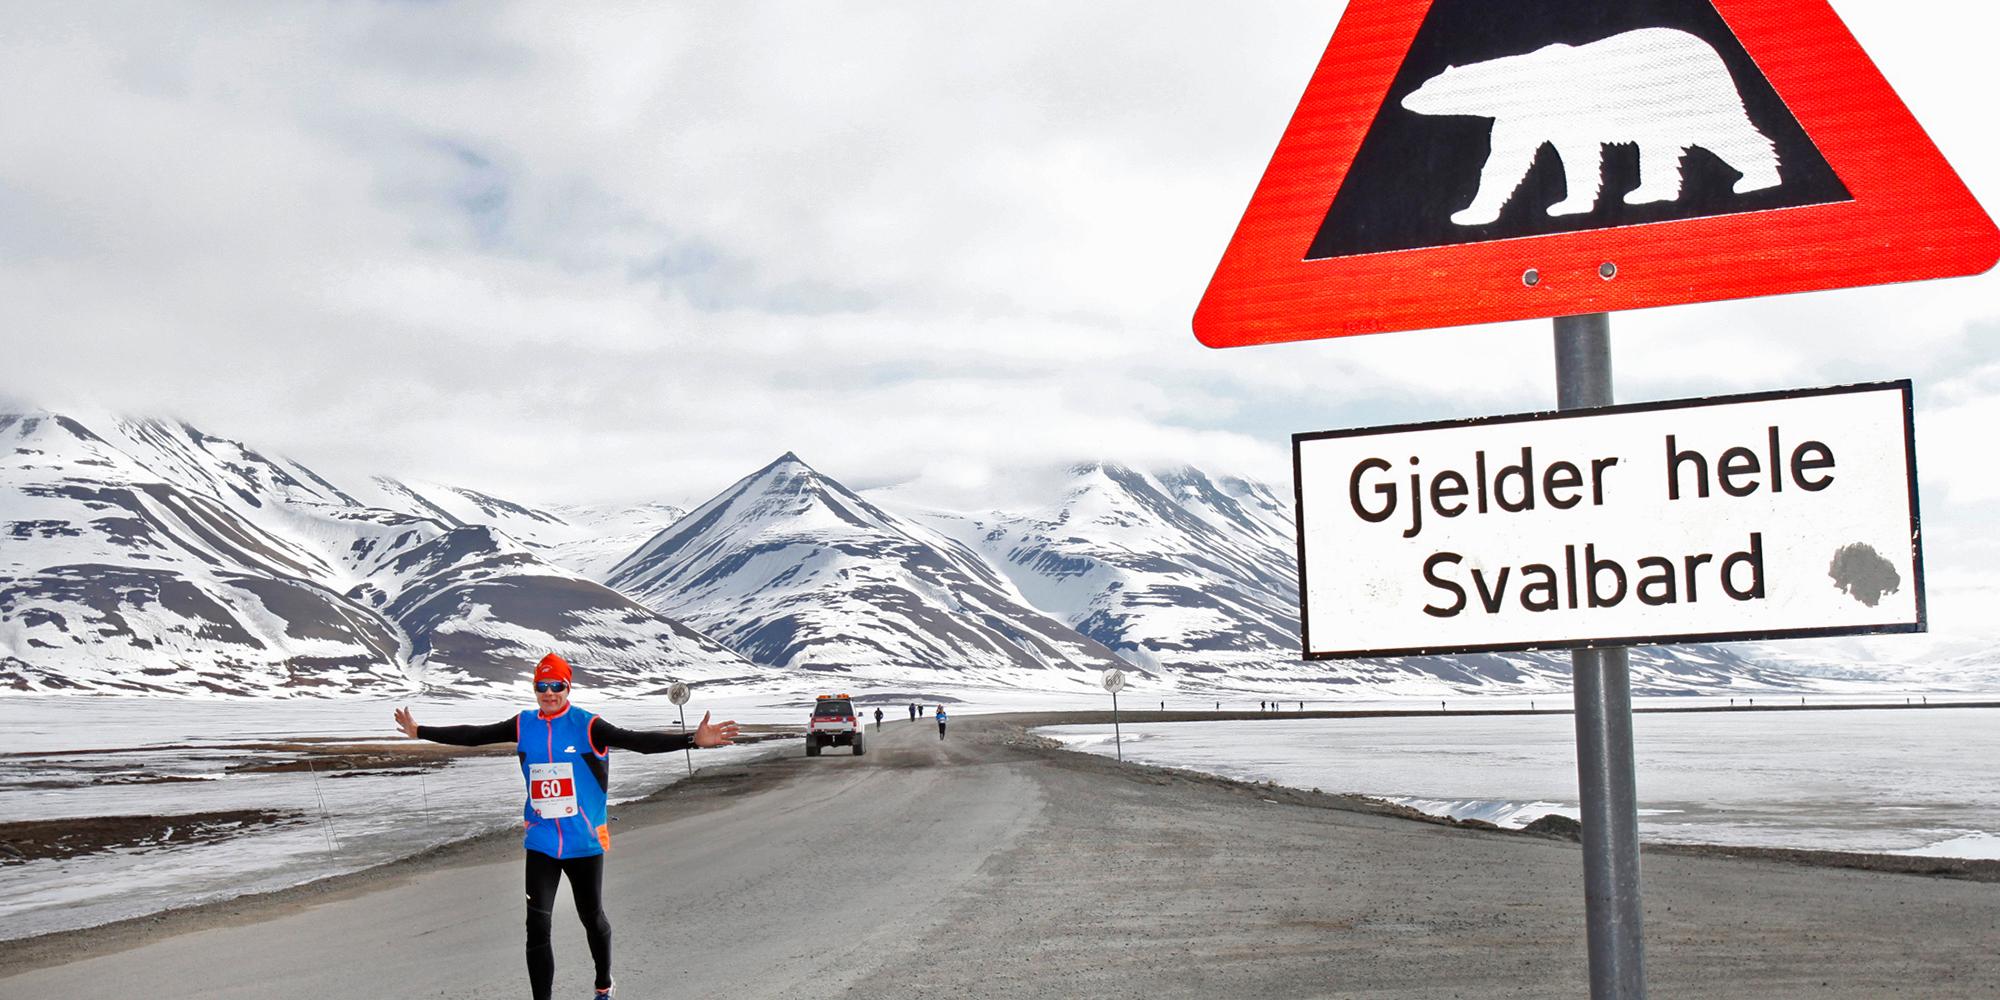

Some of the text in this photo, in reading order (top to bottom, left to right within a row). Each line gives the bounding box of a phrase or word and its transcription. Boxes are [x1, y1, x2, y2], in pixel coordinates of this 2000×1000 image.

[1350, 426, 1835, 538] Gjelder hele
[1423, 533, 1765, 617] Svalbard
[541, 780, 561, 798] 60
